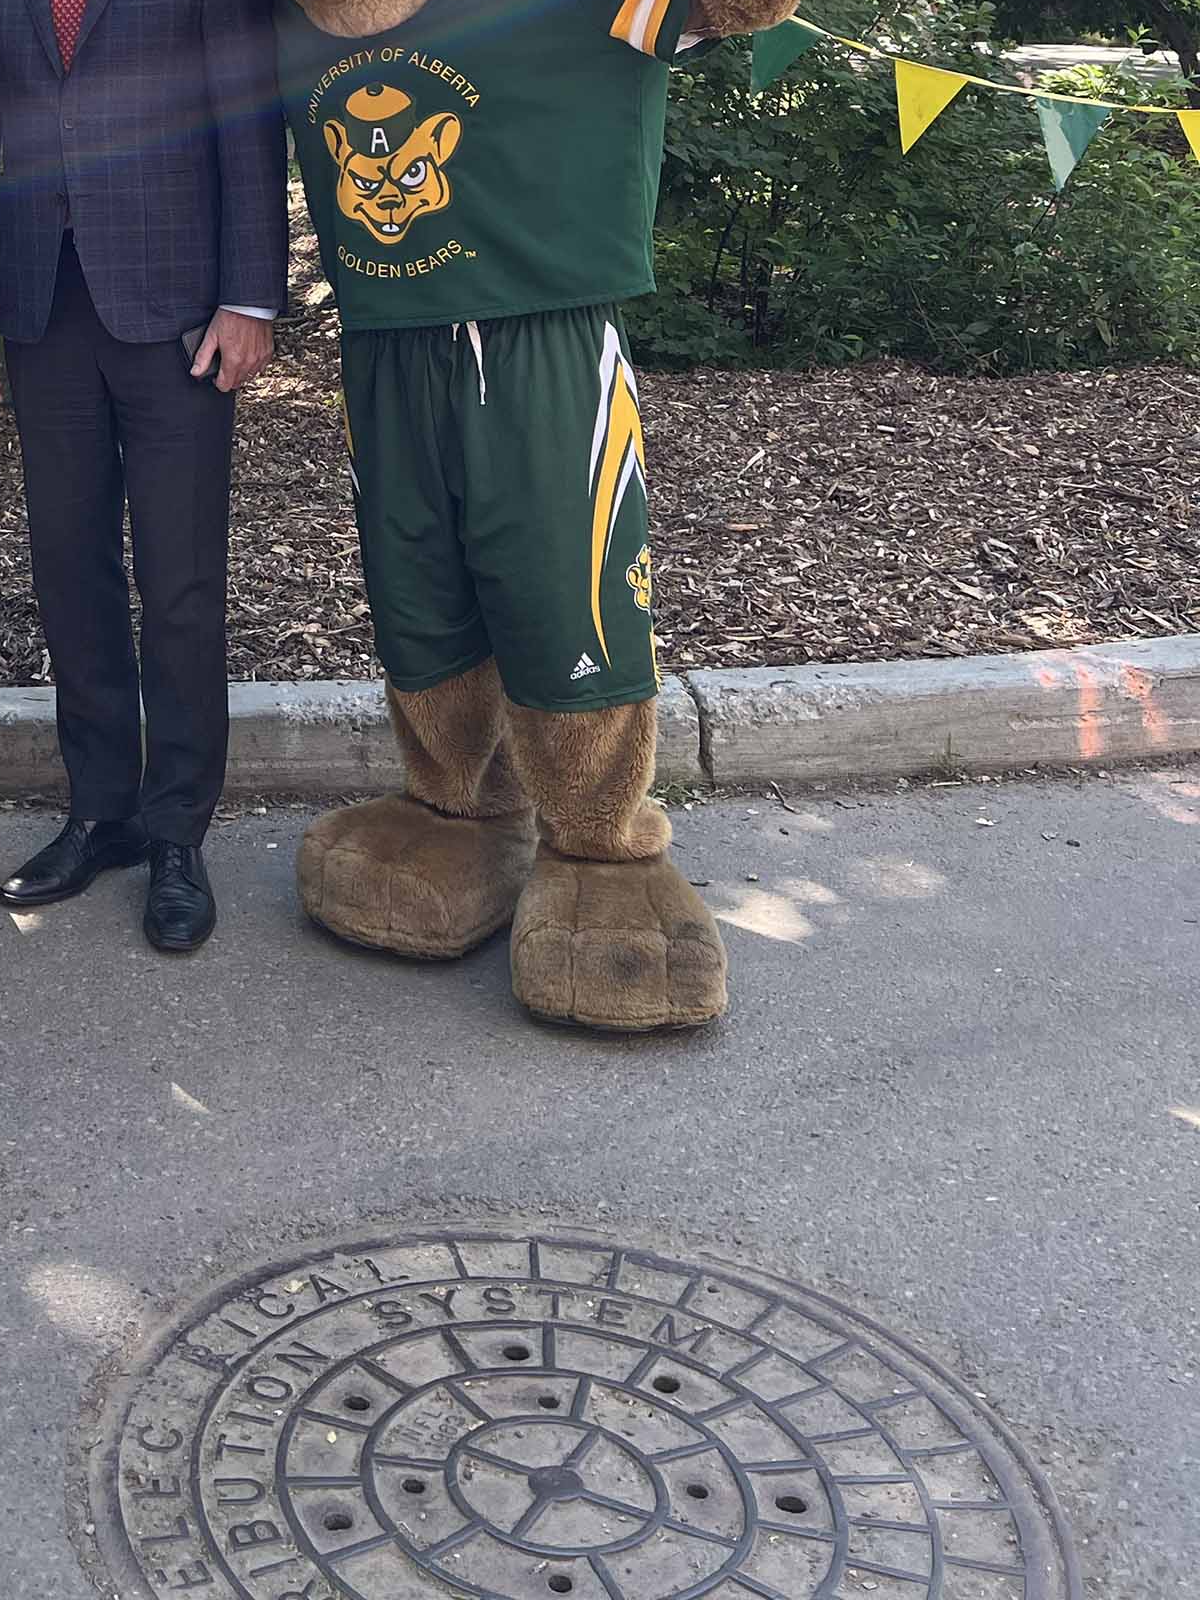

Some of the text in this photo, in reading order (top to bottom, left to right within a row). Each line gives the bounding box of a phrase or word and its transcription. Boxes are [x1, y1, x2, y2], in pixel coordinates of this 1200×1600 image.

[306, 47, 481, 124] UNIVERSITY OF ALBERTA
[371, 127, 390, 153] A
[337, 245, 400, 278] GOLDEN
[405, 239, 462, 277] BEARS
[569, 665, 601, 680] adidas
[373, 1286, 712, 1355] SYSTEM
[131, 1258, 410, 1590] ELECRICAL
